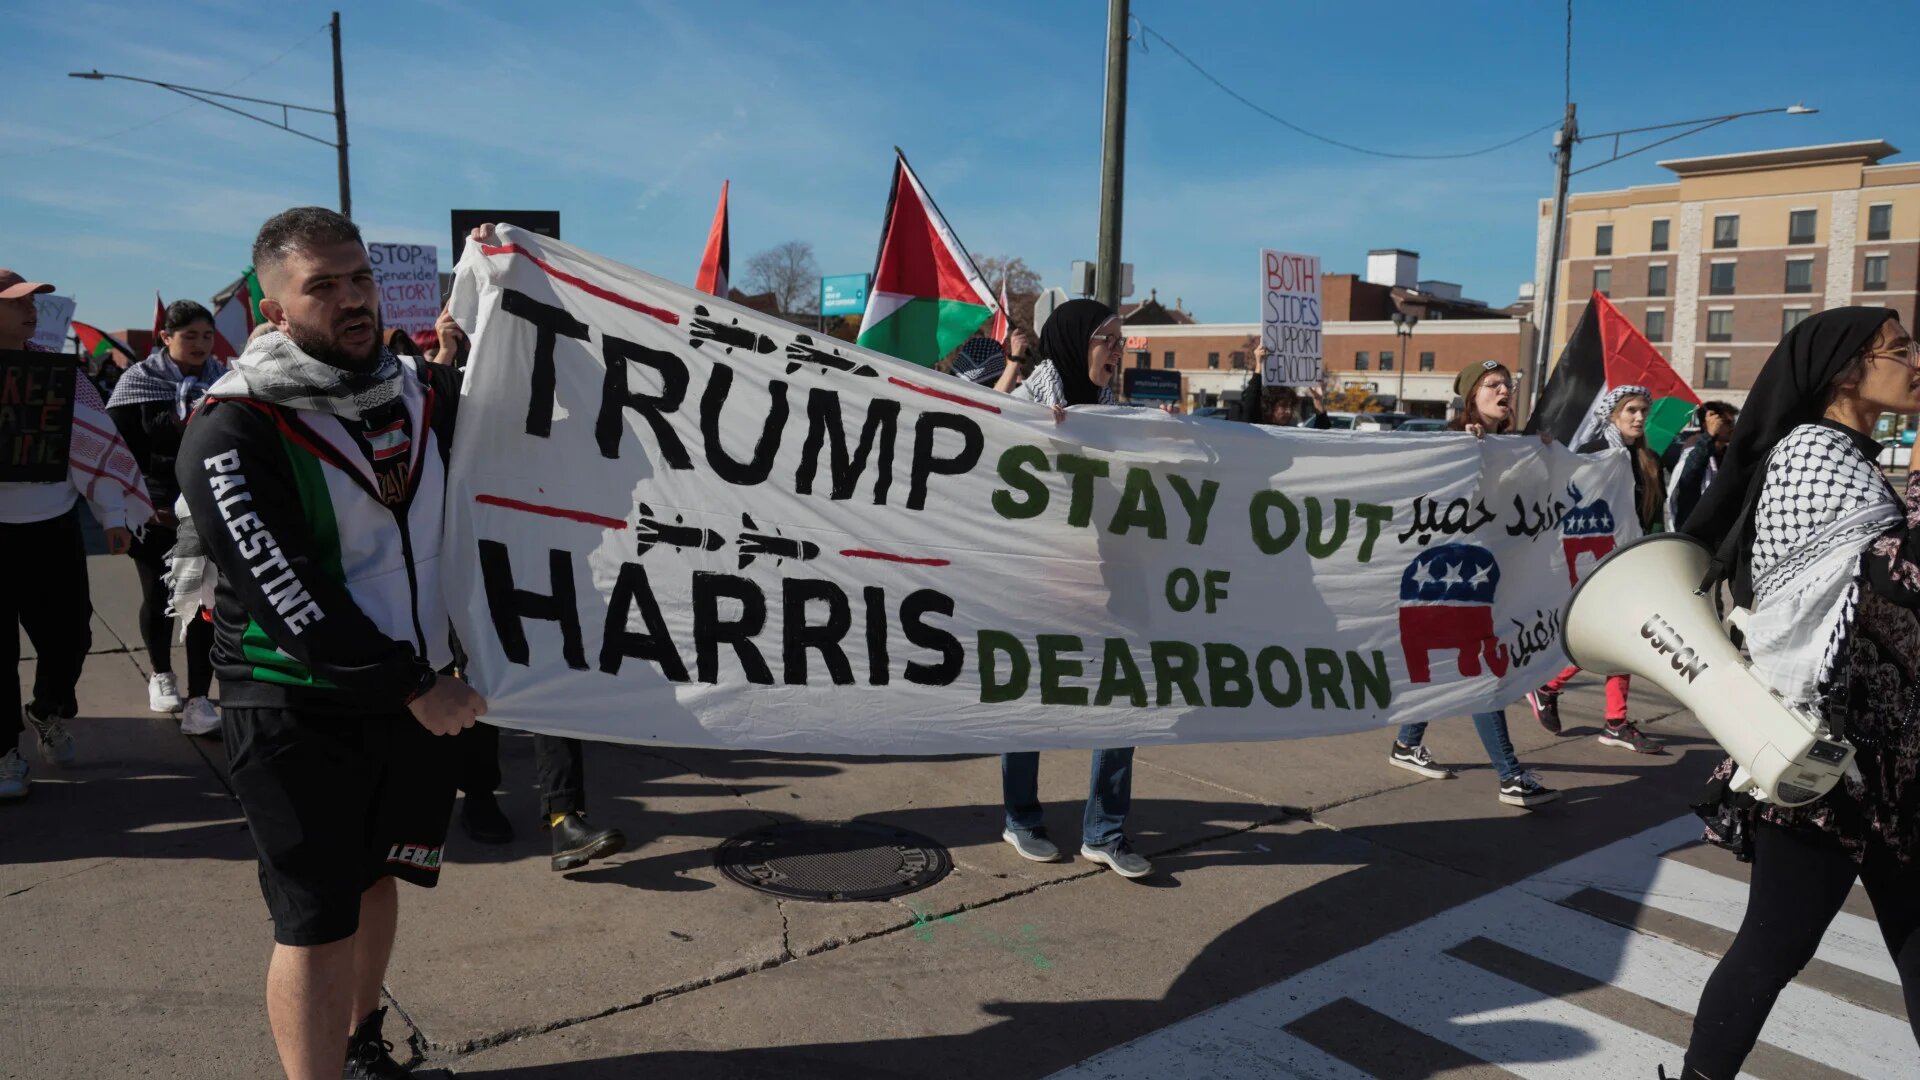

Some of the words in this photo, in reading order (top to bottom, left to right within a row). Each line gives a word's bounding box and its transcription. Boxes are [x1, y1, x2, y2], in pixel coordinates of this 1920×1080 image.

[369, 243, 423, 265] STOP
[1266, 252, 1316, 293] BOTH
[1265, 290, 1320, 327] SIDES
[1264, 324, 1322, 354] SUPPORT
[1264, 353, 1323, 383] GENOCIDE
[501, 288, 985, 511] TRUMP
[991, 445, 1220, 545] STAY
[1249, 489, 1393, 562] OUT
[204, 449, 326, 636] PALESTINE
[478, 539, 965, 688] HARRIS
[1165, 567, 1231, 614] OF
[977, 629, 1393, 709] DEARBORN
[1640, 613, 1709, 685] USPCN
